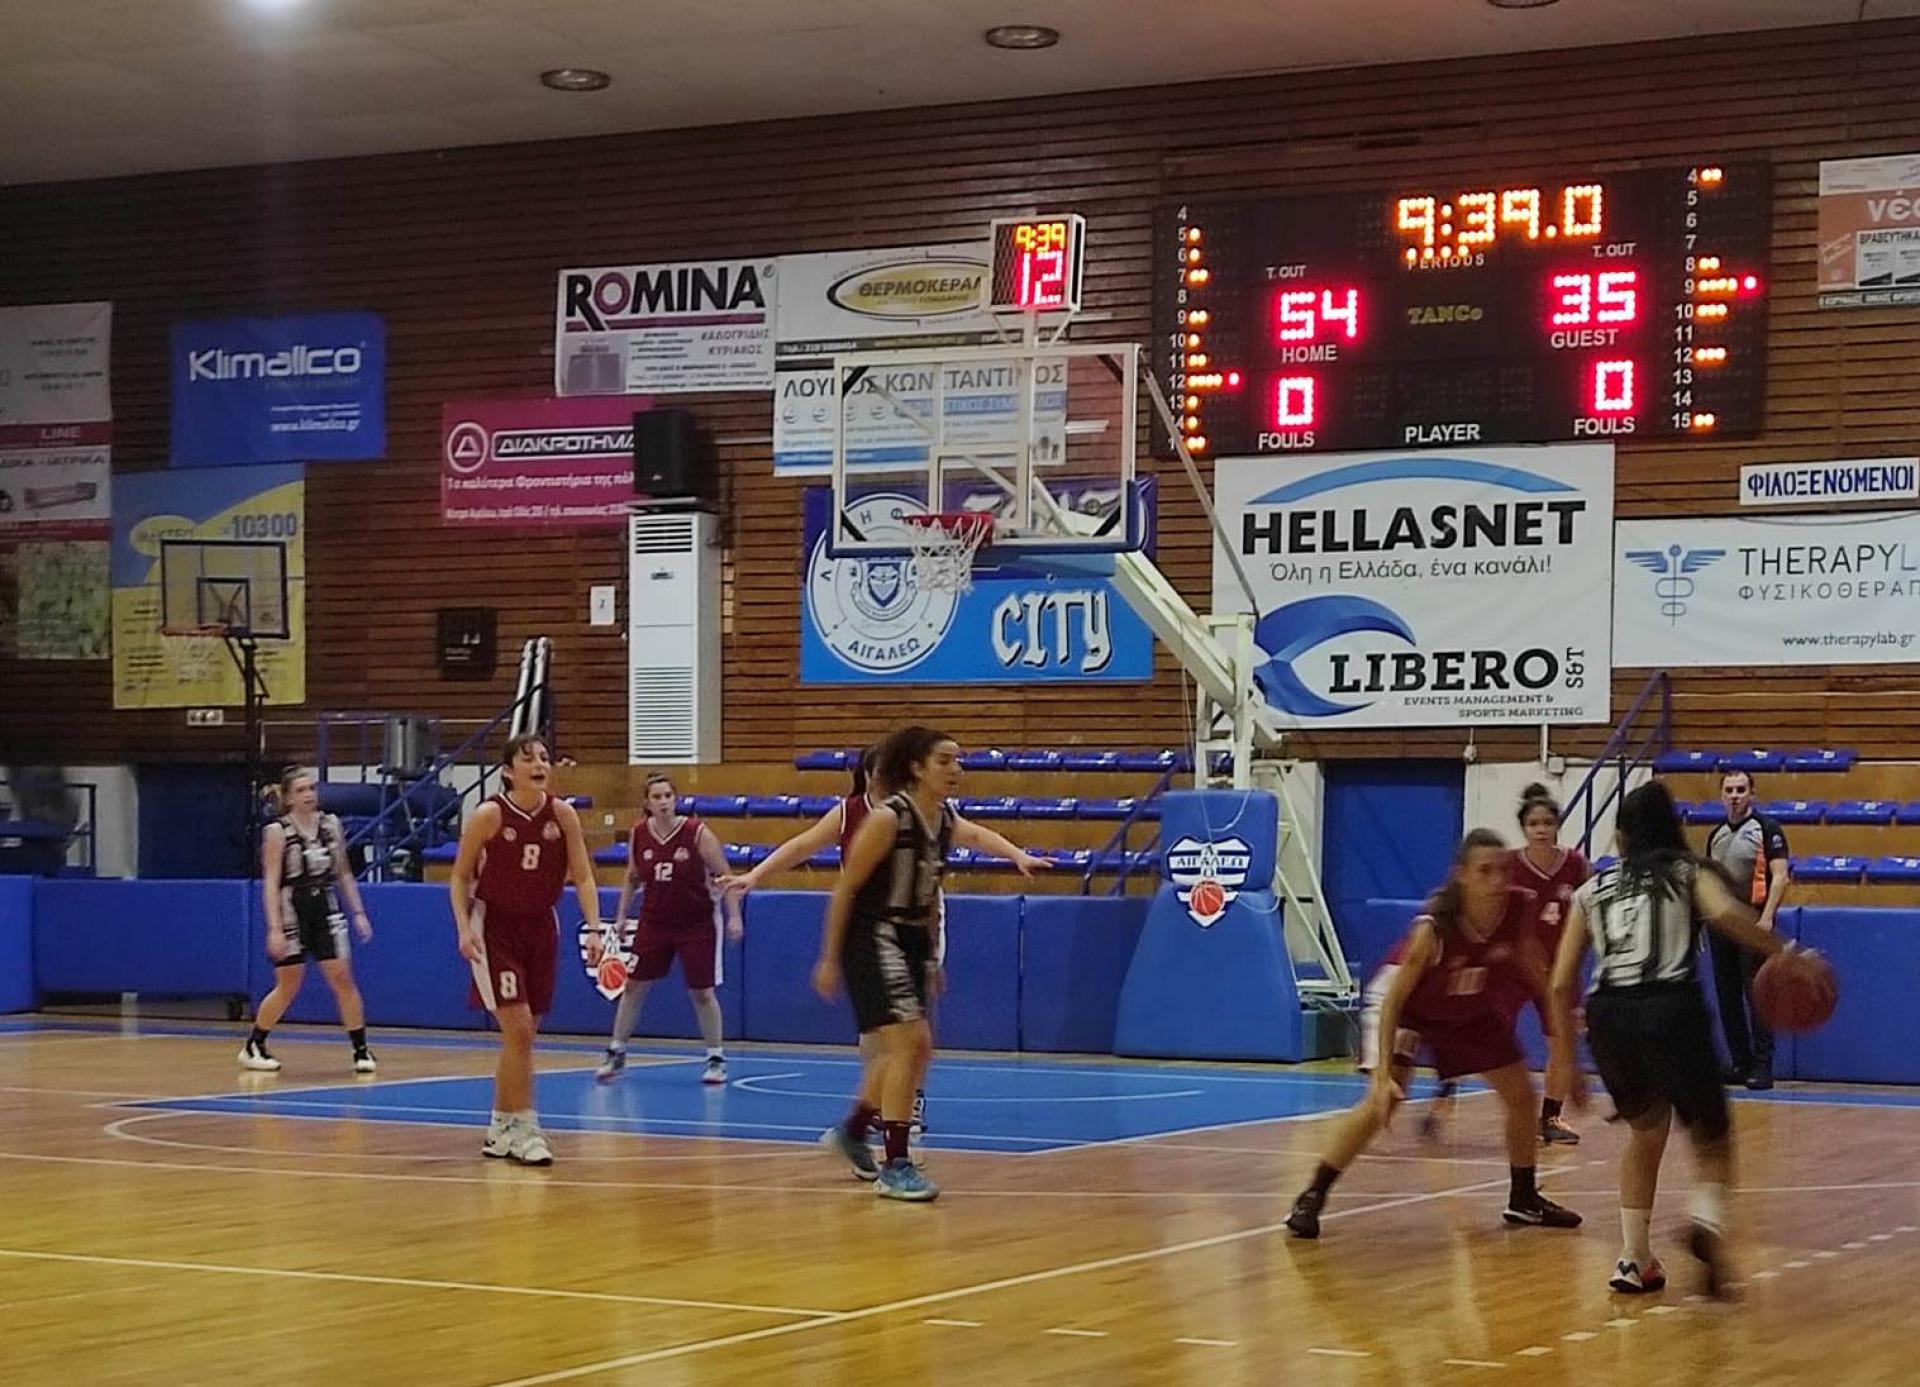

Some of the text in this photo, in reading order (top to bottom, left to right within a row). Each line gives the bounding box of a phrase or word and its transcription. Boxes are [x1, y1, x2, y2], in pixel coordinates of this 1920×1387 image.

[1687, 168, 1698, 183] 4
[1687, 191, 1697, 206] 5
[1177, 206, 1187, 221] 4
[1398, 185, 1603, 246] 9:39.0
[1686, 213, 1697, 228] 6
[1015, 223, 1066, 252] 9:39
[1177, 228, 1187, 241] 5
[1685, 235, 1697, 250] 7
[1177, 248, 1187, 262] 6
[1685, 257, 1696, 272] 8
[1020, 250, 1064, 306] 12
[1177, 269, 1187, 283] 7
[1684, 279, 1695, 294] 9
[565, 265, 766, 331] ROMINA
[1177, 289, 1187, 303] 8
[1553, 271, 1637, 325] 35
[1177, 310, 1187, 324] 9
[1280, 288, 1358, 341] 54
[1674, 303, 1695, 318] 10
[1169, 333, 1187, 347] 10
[1551, 328, 1620, 349] GUEST
[1674, 326, 1693, 341] 11
[1169, 354, 1187, 368] 11
[1282, 344, 1338, 364] HOME
[1673, 347, 1694, 363] 12
[1168, 373, 1186, 388] 12
[1672, 369, 1693, 384] 13
[1594, 360, 1634, 411] 0
[1168, 395, 1185, 409] 13
[1278, 376, 1315, 426] 0
[1672, 391, 1693, 407] 14
[1573, 415, 1636, 436] FOULS
[1671, 412, 1692, 429] 15
[1258, 431, 1315, 450] FOULS
[1405, 423, 1481, 444] PLAYER
[1242, 500, 1587, 555] HELLASNET
[1269, 554, 1551, 585] Όλη η Ελλάδα, ένα κανάλι!
[1782, 631, 1916, 648] www.therapylab.gr
[848, 637, 921, 661] ΑΙΓΑΛΕΩ
[1328, 646, 1585, 694] LIBERO S&T
[1404, 696, 1451, 706] EVENTS
[1452, 694, 1543, 705] MANAGEMENT
[1458, 707, 1584, 719] SPORTS MARKETING
[521, 843, 541, 871] 8
[653, 861, 674, 882] 12
[1540, 901, 1560, 926] 4
[499, 970, 518, 999] 8
